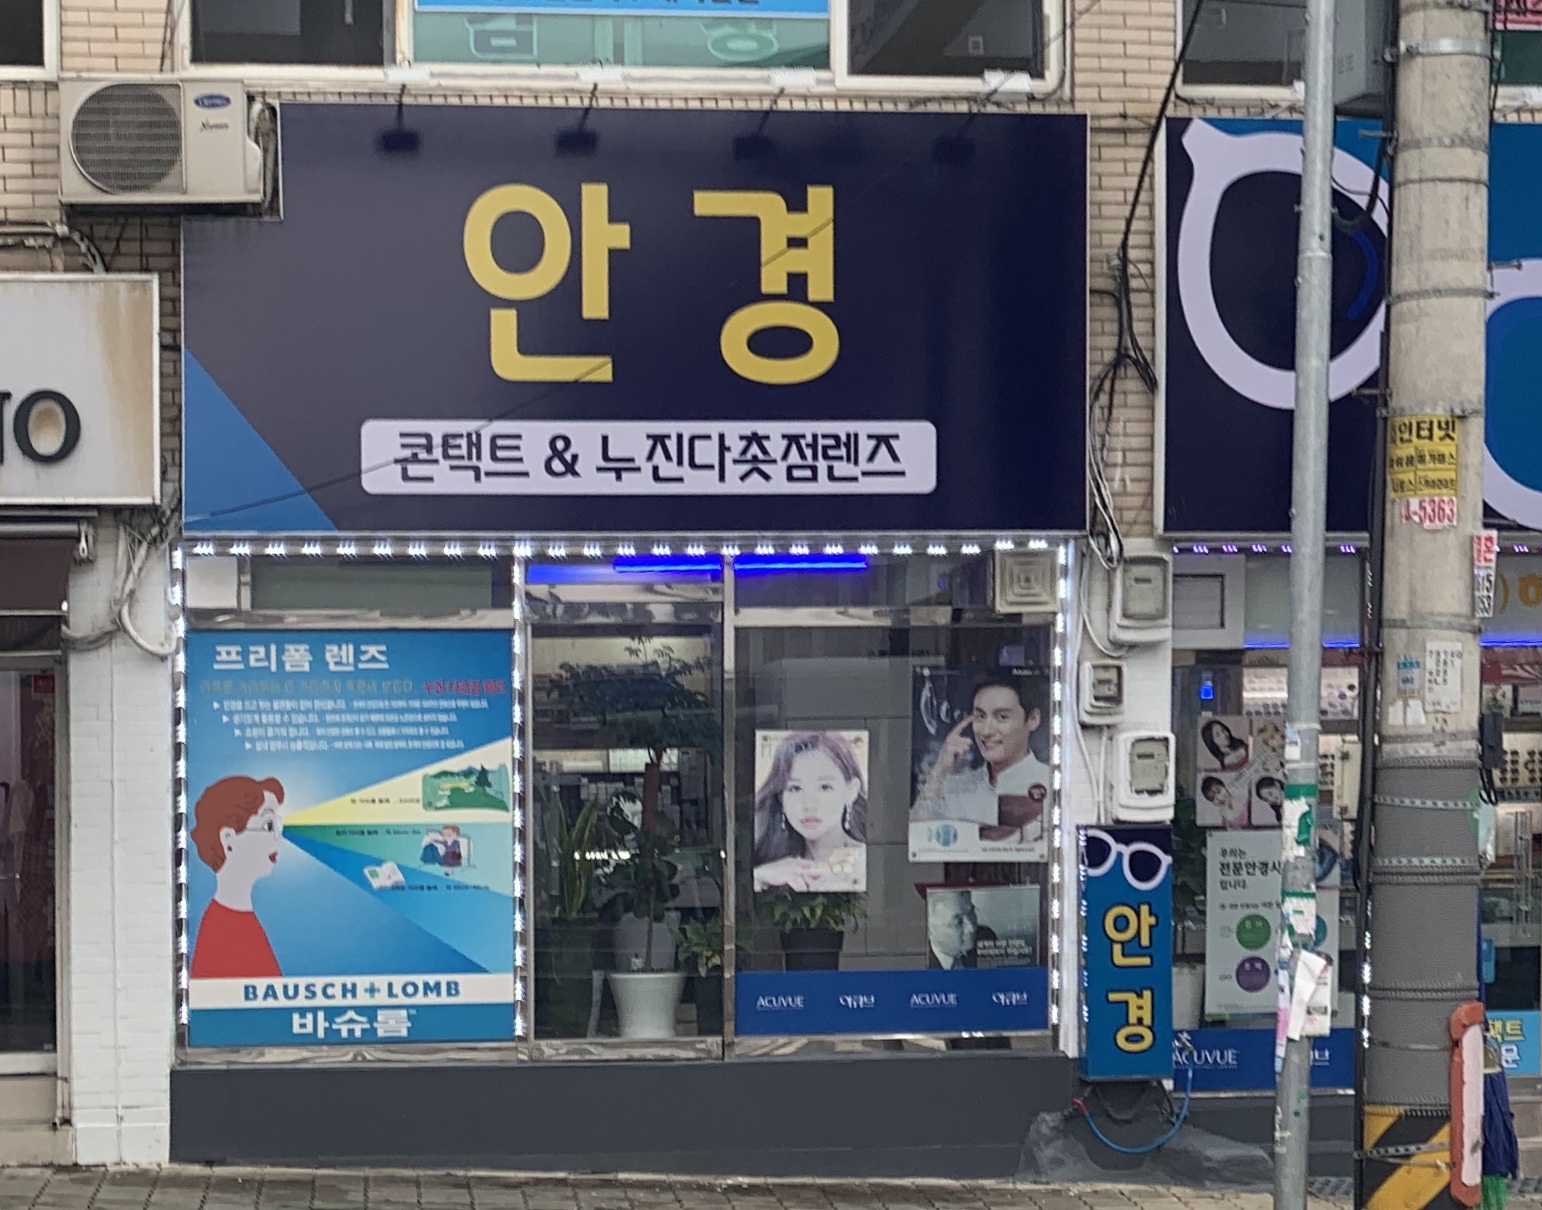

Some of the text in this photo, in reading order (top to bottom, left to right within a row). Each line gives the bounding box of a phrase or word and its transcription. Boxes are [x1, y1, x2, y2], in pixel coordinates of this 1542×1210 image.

[394, 430, 907, 484] 콘택트 & 누진다촛점렌즈
[212, 642, 390, 672] 프리폼 렌즈
[1103, 903, 1158, 1053] 안경
[757, 995, 805, 1009] ACUVUE
[910, 993, 958, 1007] ACUVUE
[291, 1008, 412, 1039] 바슈롬
